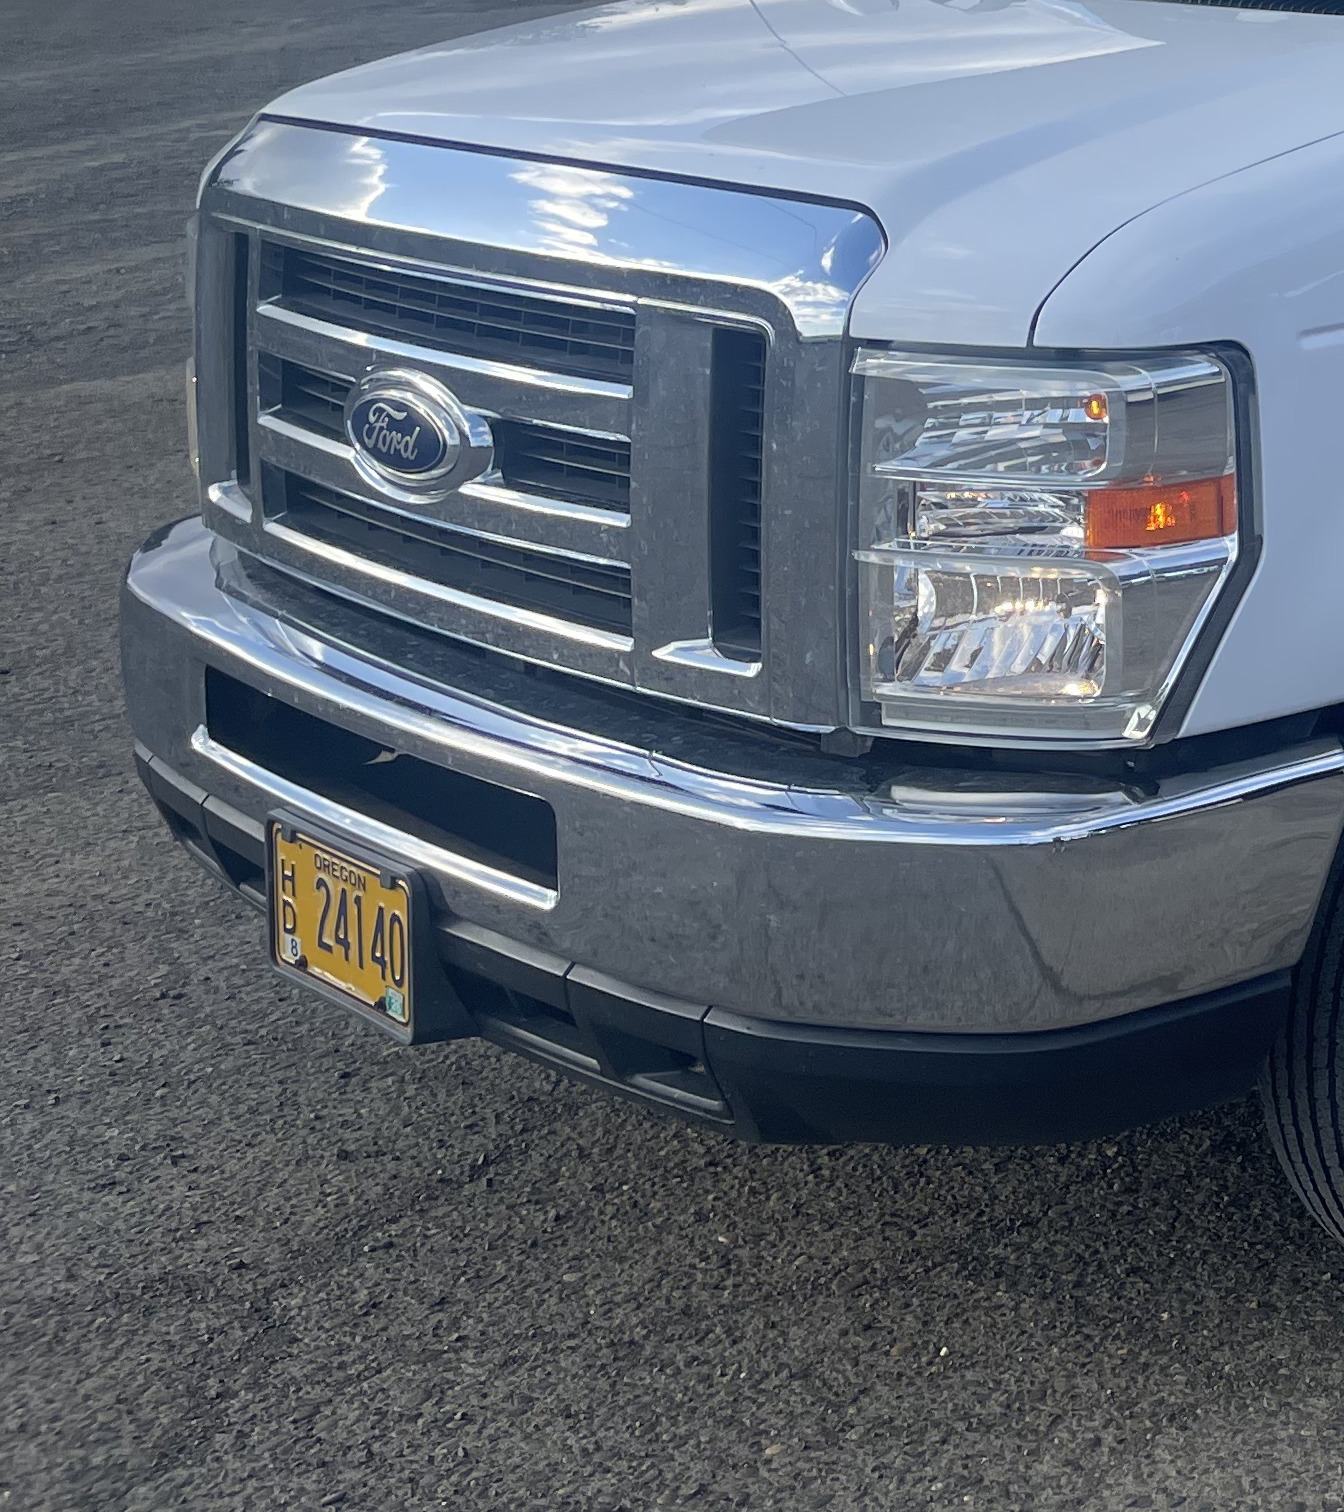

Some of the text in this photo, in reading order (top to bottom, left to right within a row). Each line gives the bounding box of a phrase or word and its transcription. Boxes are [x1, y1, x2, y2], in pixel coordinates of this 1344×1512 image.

[362, 402, 422, 461] Ford
[314, 852, 367, 892] OREGON
[290, 937, 299, 958] 8
[315, 876, 405, 988] 24140
